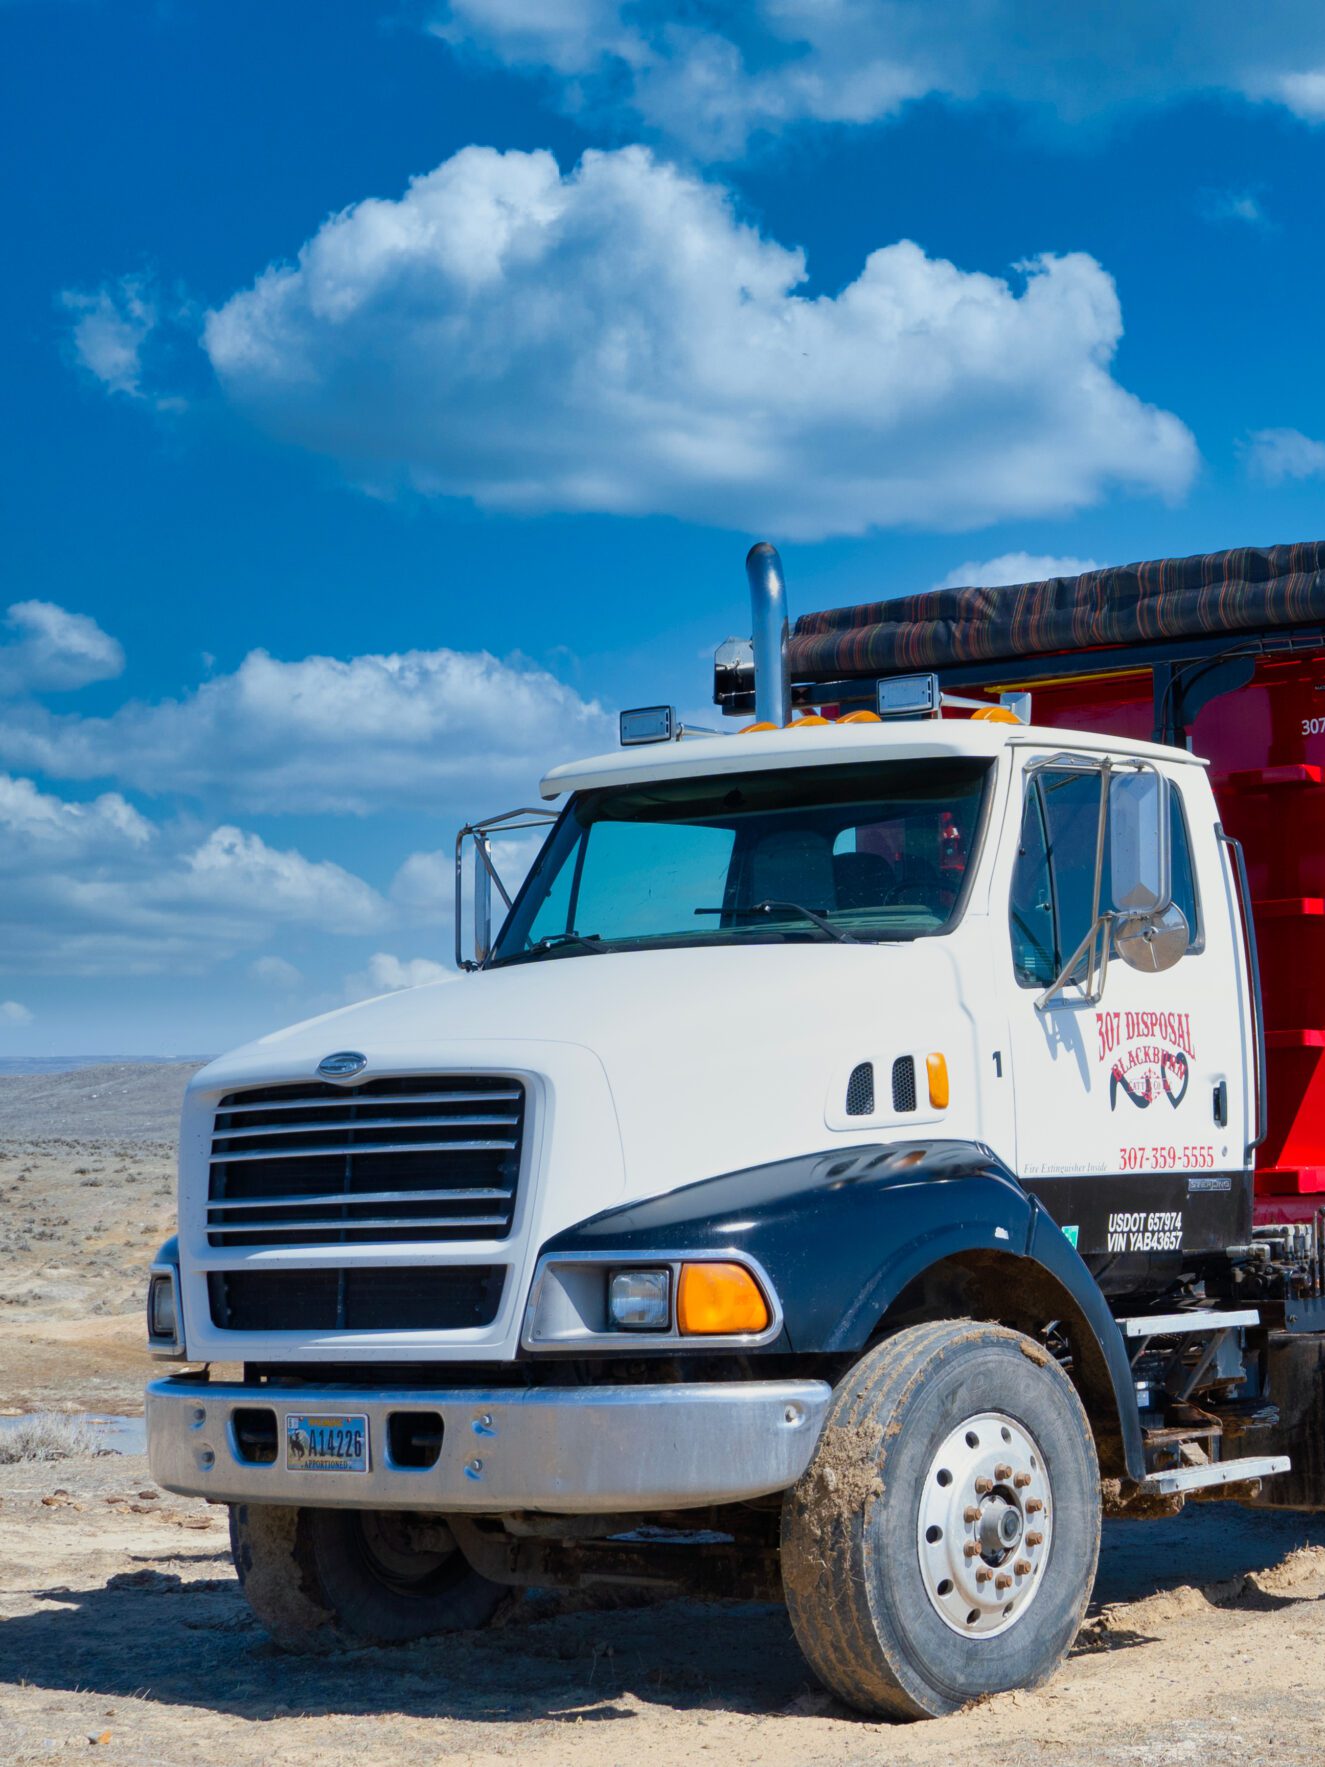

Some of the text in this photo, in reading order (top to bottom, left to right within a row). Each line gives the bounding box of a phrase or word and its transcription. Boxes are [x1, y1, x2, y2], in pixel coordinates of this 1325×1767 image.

[1096, 1011, 1197, 1062] 307 DISPOSAL
[992, 1051, 1002, 1078] 1
[1111, 1046, 1187, 1082] BLACKBURN
[1024, 1161, 1107, 1175] Fire Extinguisher Inside
[1119, 1146, 1215, 1171] 307-359-5555
[1108, 1211, 1182, 1233] USDOT 657974
[1107, 1231, 1183, 1252] VIN YAB43657
[308, 1429, 363, 1458] A14226
